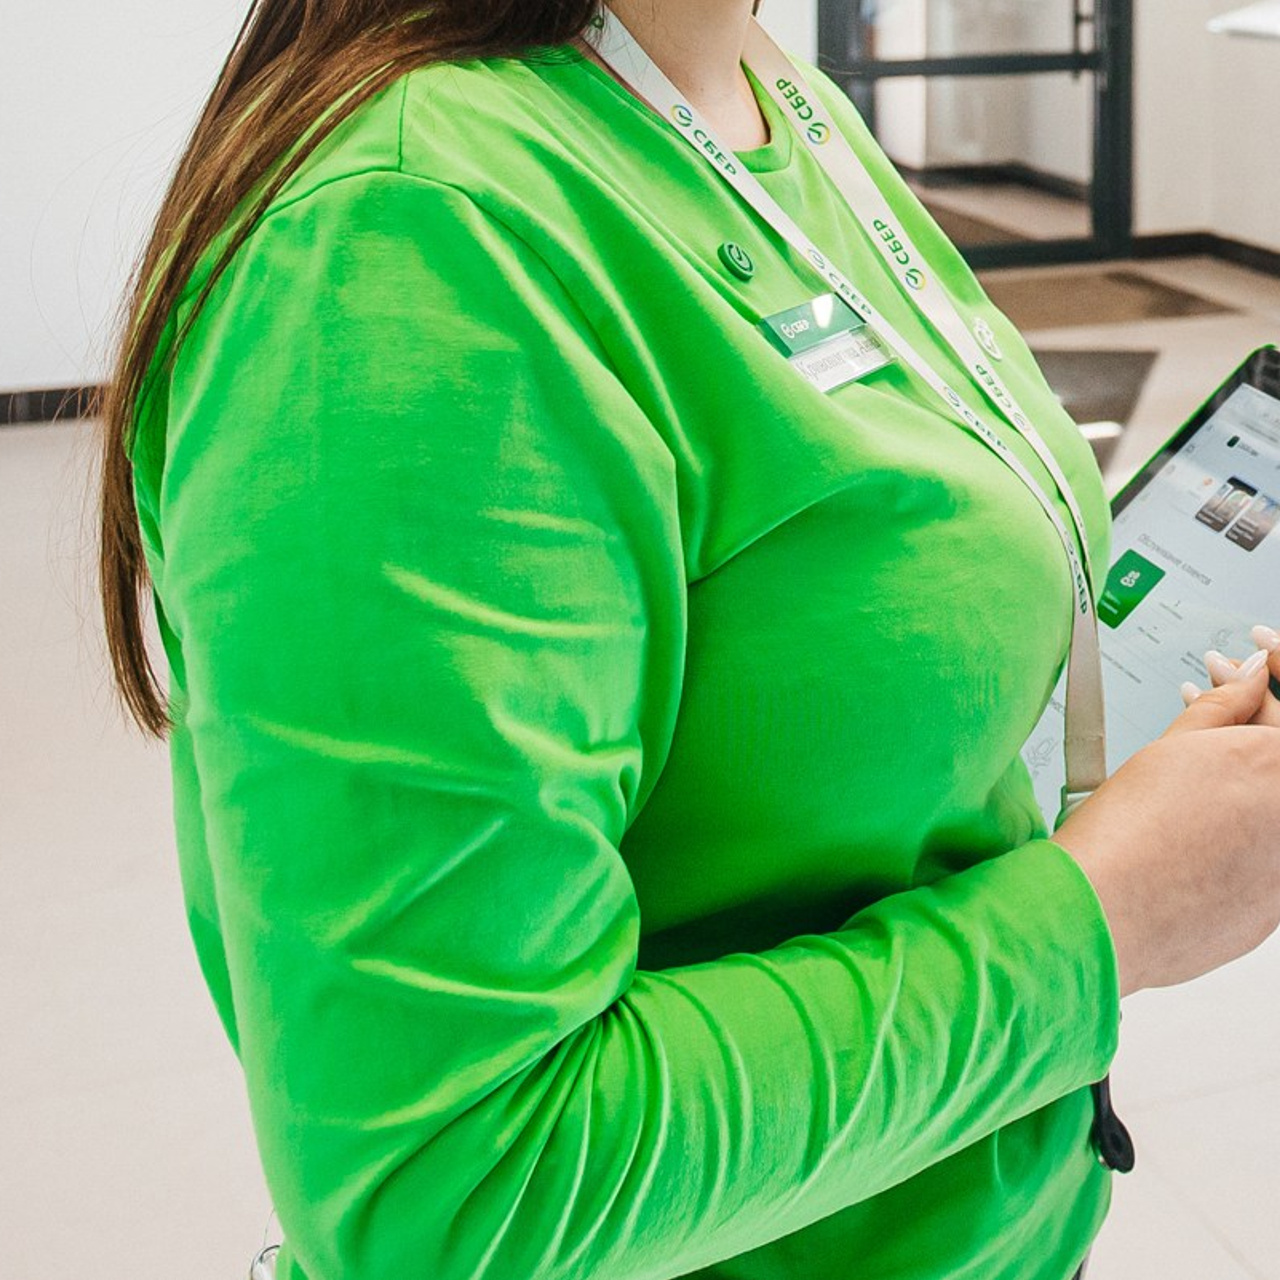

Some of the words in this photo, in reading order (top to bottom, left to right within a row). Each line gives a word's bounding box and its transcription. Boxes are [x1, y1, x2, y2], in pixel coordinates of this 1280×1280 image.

[776, 78, 813, 120] СБЕР
[693, 129, 737, 175] СБЕР
[873, 219, 910, 265] СБЕР
[829, 272, 872, 315] СБЕР
[975, 364, 1012, 409] СБЕР
